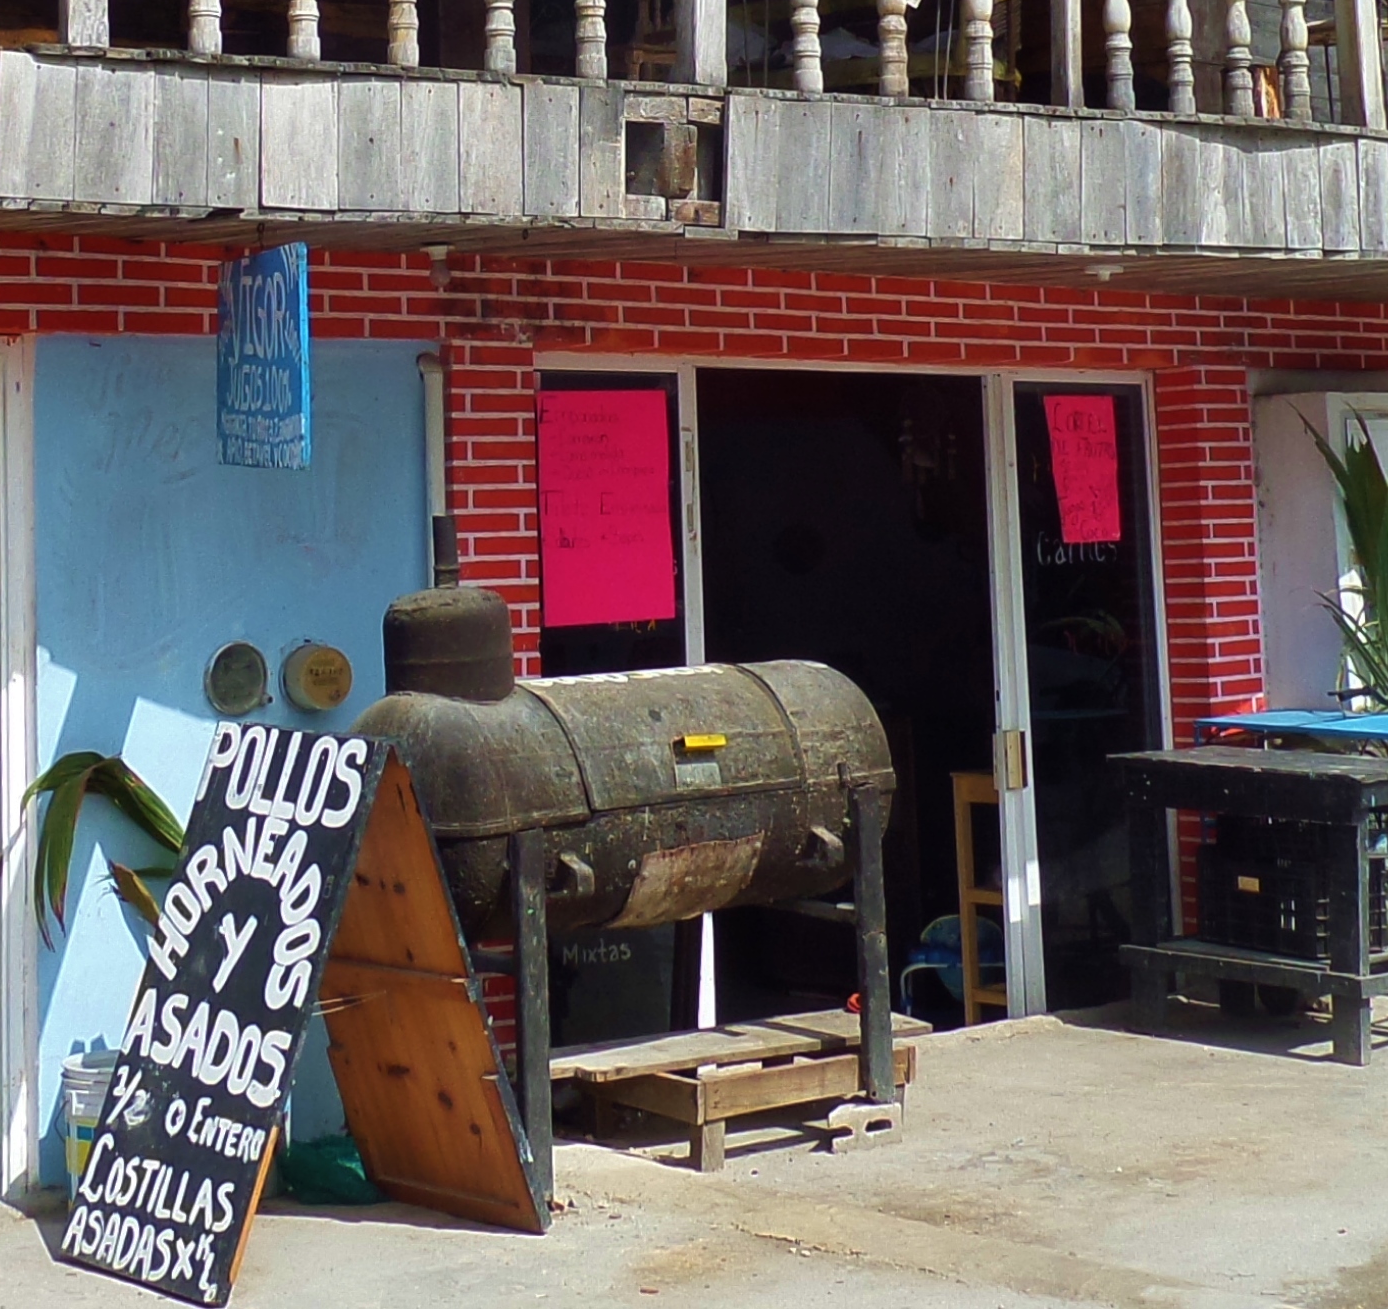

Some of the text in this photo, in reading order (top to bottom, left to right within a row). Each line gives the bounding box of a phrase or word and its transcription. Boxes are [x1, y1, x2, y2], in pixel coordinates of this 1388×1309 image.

[227, 357, 264, 411] JUGOS
[197, 722, 368, 828] POLLOS
[148, 817, 323, 1010] HORNEADOS
[213, 911, 259, 993] Y
[121, 987, 293, 1108] ASADOS
[79, 1133, 235, 1233] COSTILLAS
[62, 1206, 175, 1282] ASADAS
